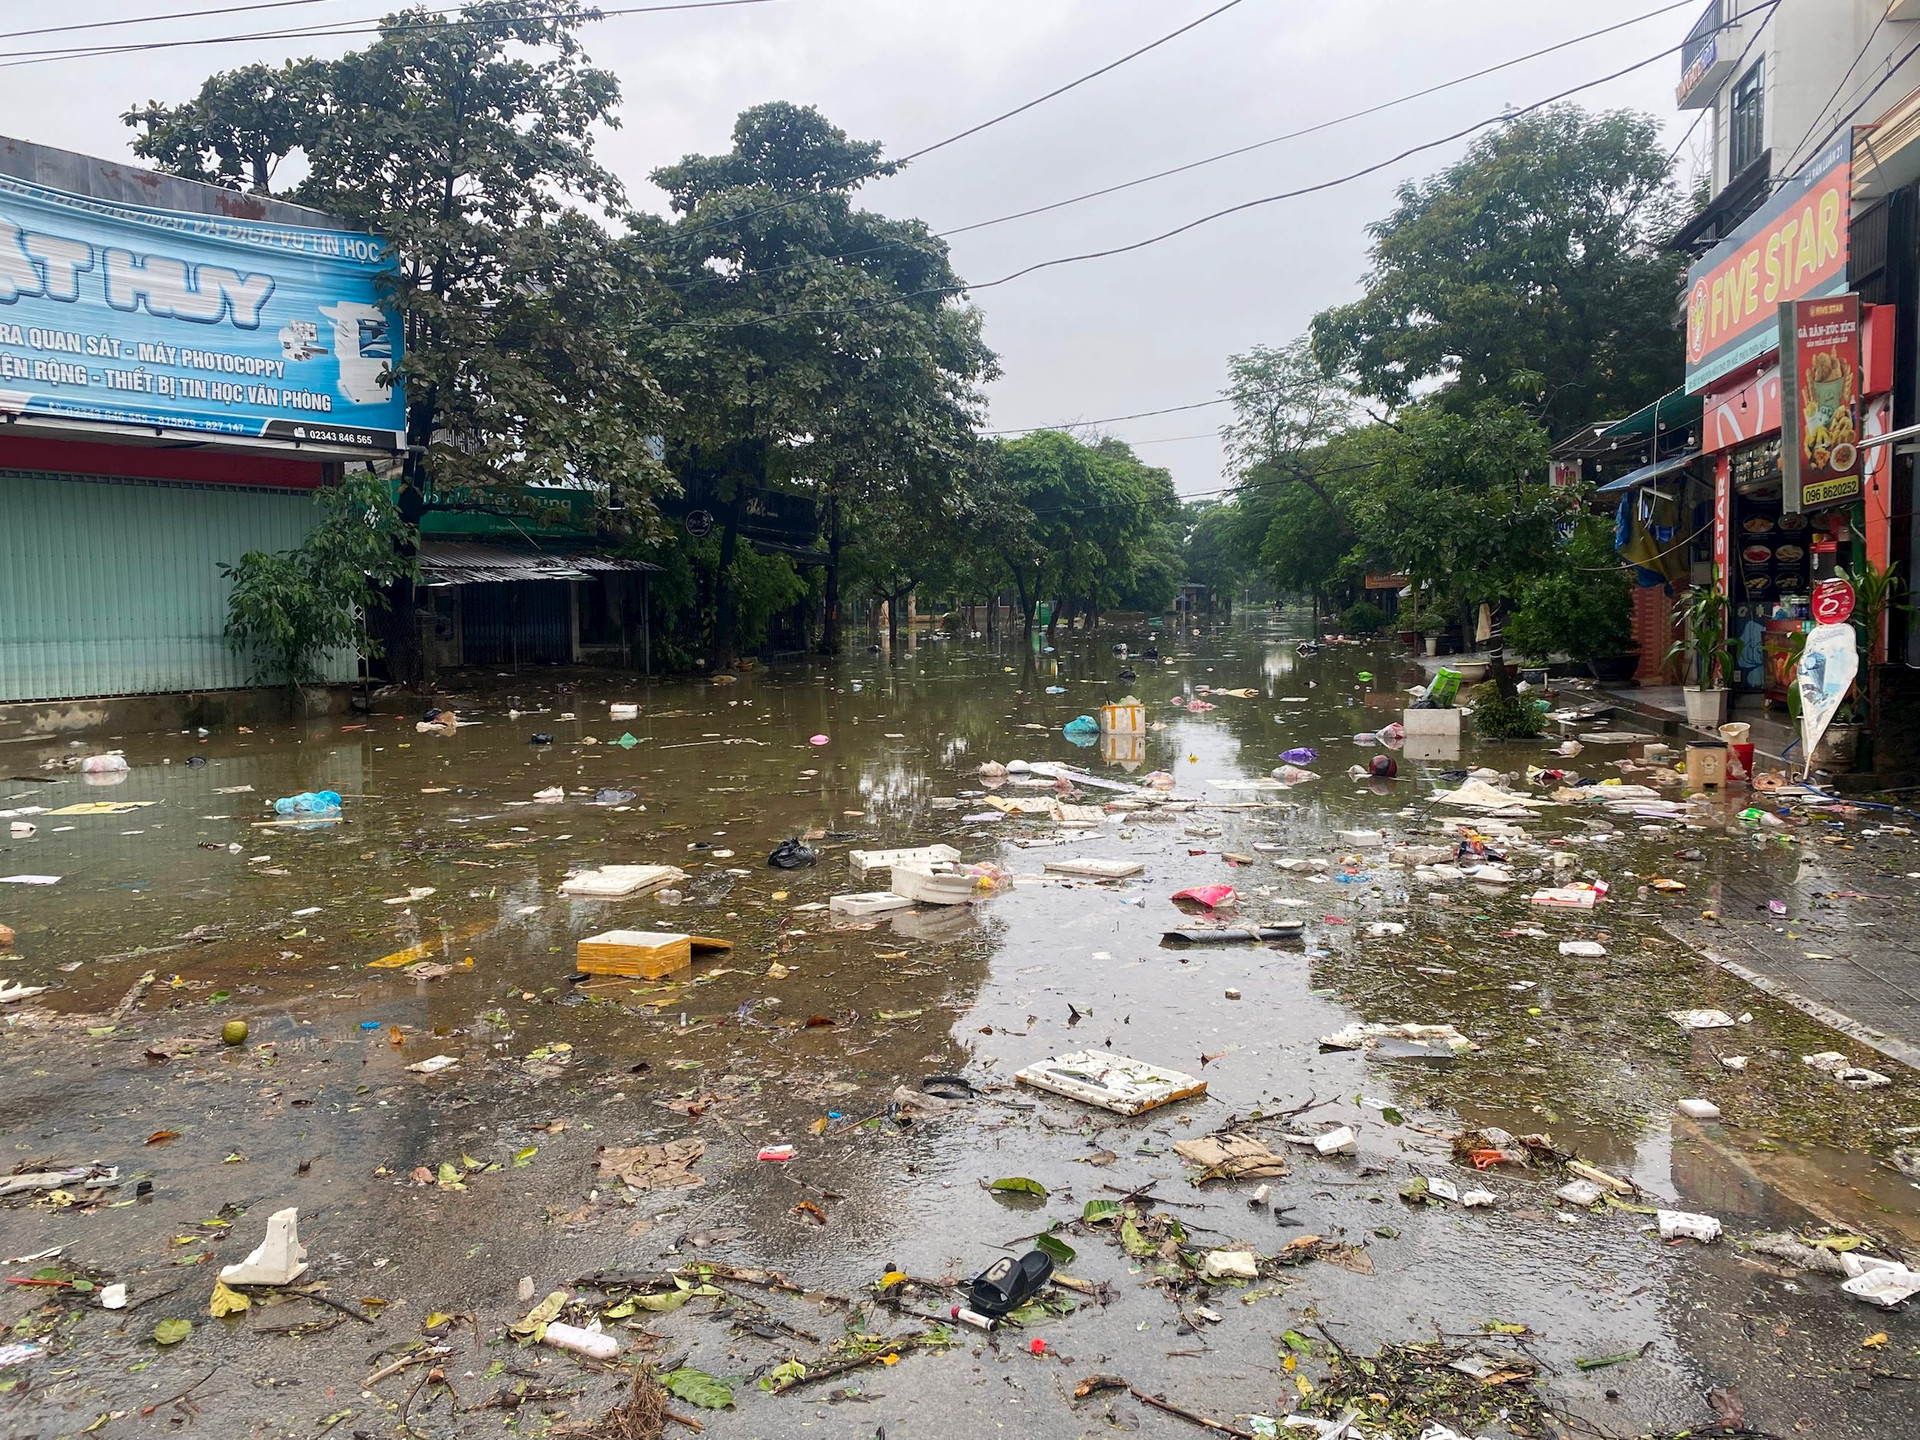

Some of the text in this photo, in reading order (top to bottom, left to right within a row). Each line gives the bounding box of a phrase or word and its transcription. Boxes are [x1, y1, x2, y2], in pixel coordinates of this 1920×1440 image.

[311, 233, 340, 256] TIN
[343, 238, 381, 266] HỌC
[1711, 188, 1840, 338] FIVE STAR
[101, 245, 276, 331] HUY
[28, 327, 82, 354] QUAN
[86, 332, 121, 360] SÁT
[137, 341, 177, 366] MÁY
[180, 347, 285, 380] PHOTOCOPPY
[1797, 324, 1808, 339] GÀ
[33, 357, 88, 387] RỘNG
[104, 365, 153, 393] THIẾT
[157, 375, 176, 400] BỊ
[179, 377, 207, 399] TIN
[211, 382, 243, 406] HỌC
[246, 383, 281, 407] VĂN
[282, 387, 332, 412] PHÒNG
[309, 429, 373, 446] 02343 846 565
[1717, 476, 1726, 554] STAR
[1805, 488, 1821, 503] 096
[1822, 480, 1857, 499] 8620252
